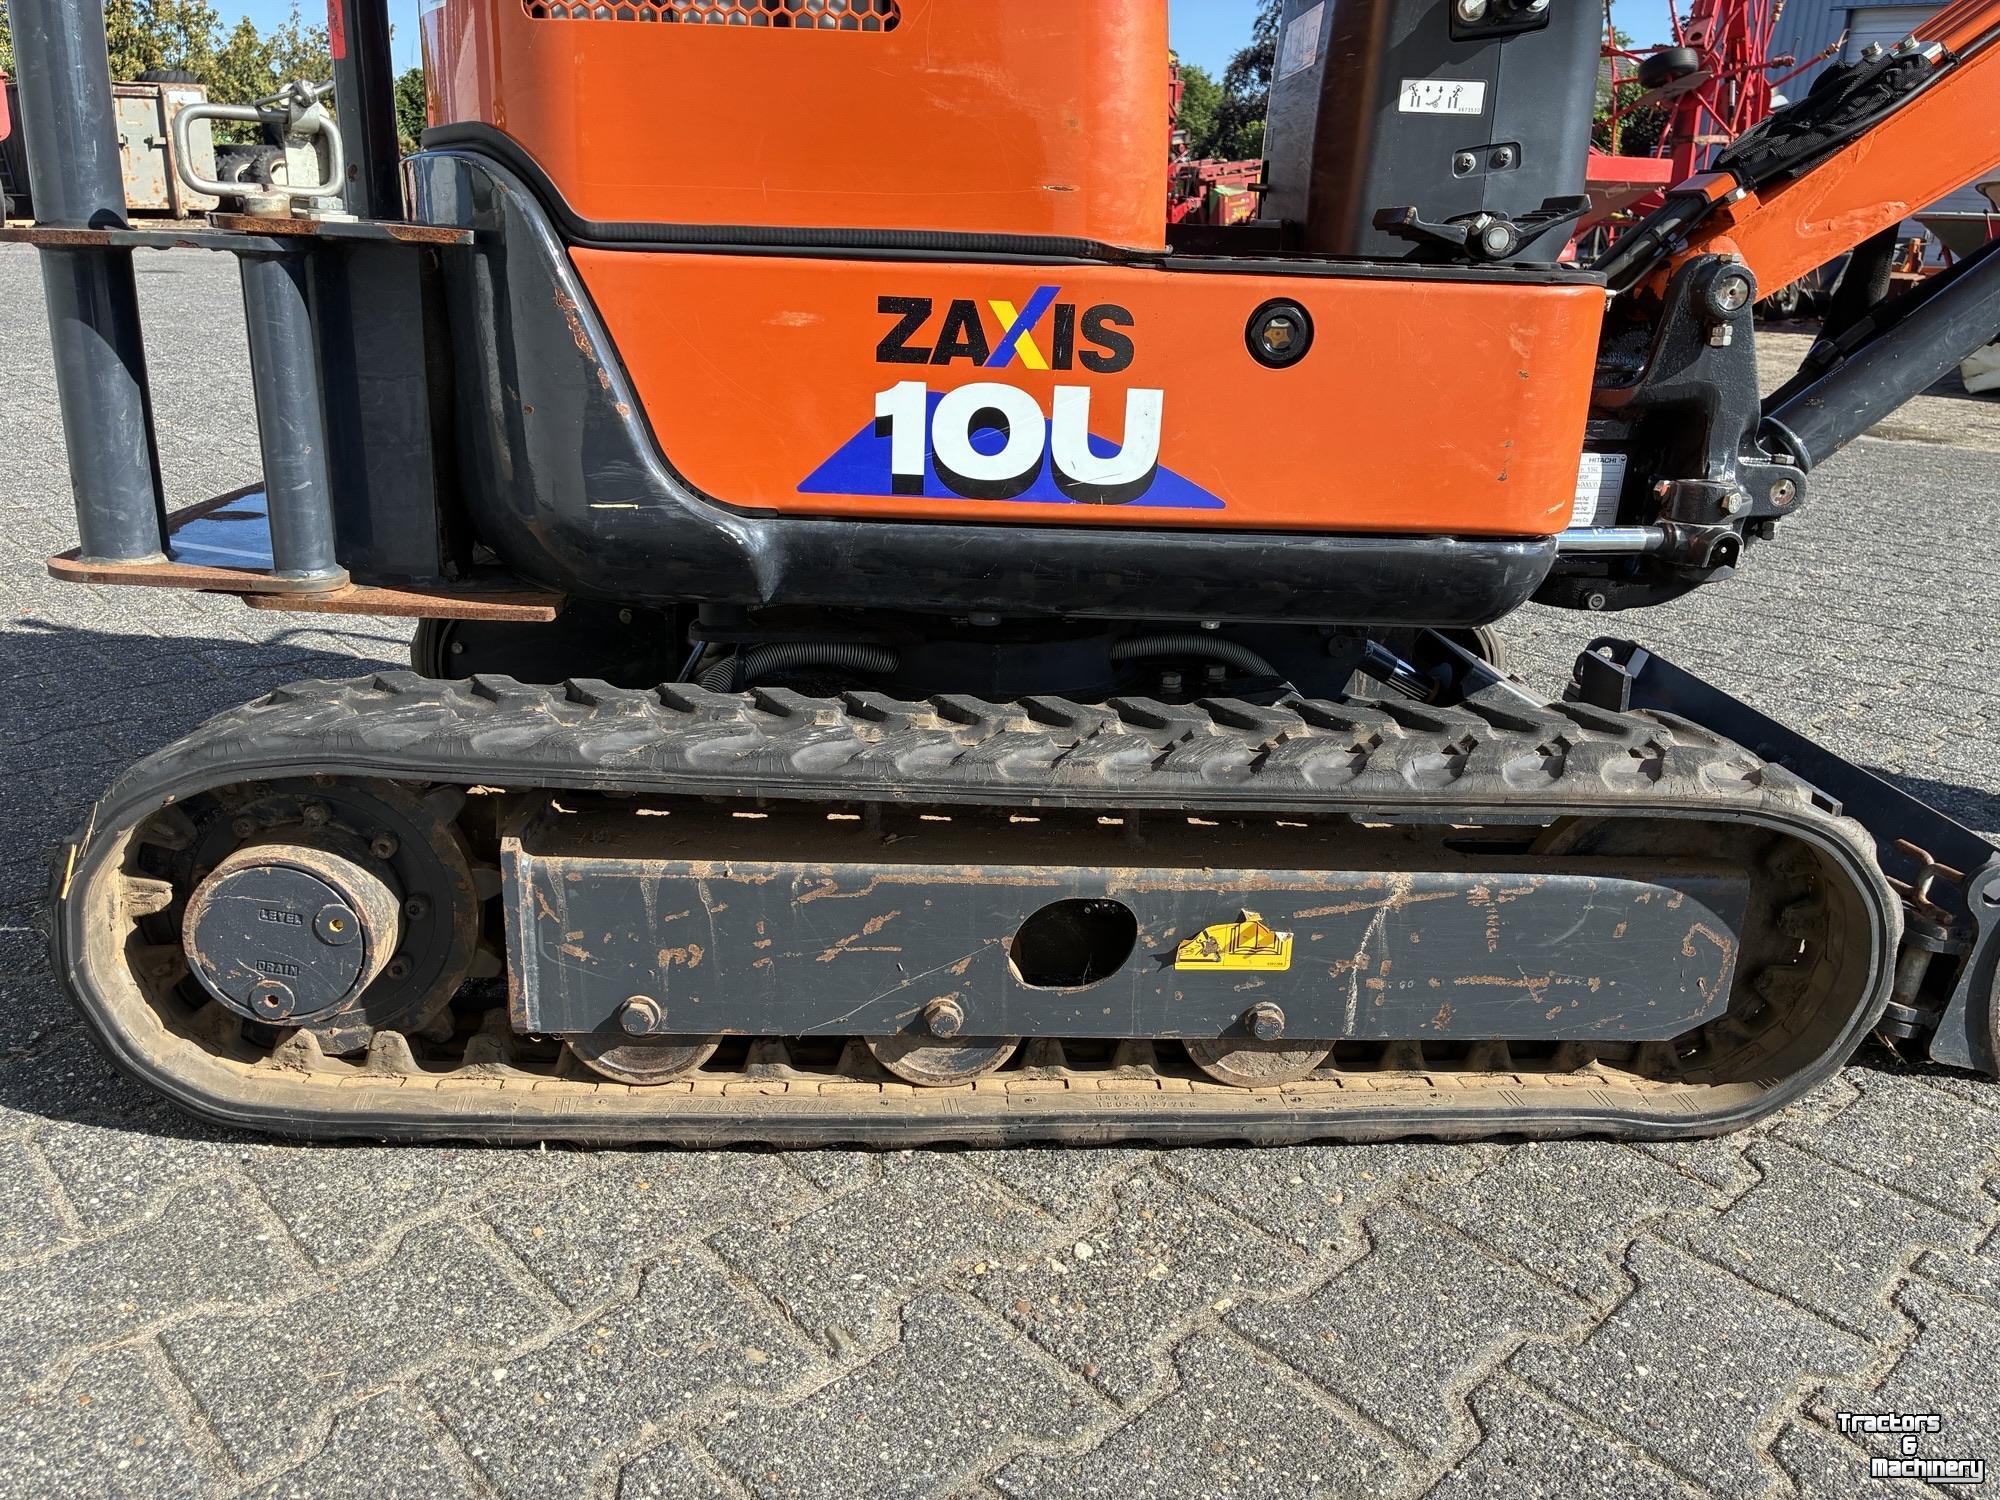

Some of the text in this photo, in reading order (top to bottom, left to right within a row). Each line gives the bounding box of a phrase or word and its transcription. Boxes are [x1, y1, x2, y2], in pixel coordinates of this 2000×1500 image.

[875, 285, 1135, 374] ZAXIS
[874, 380, 1165, 504] 10U
[259, 908, 303, 925] LEVEL
[256, 960, 299, 976] DRAIN
